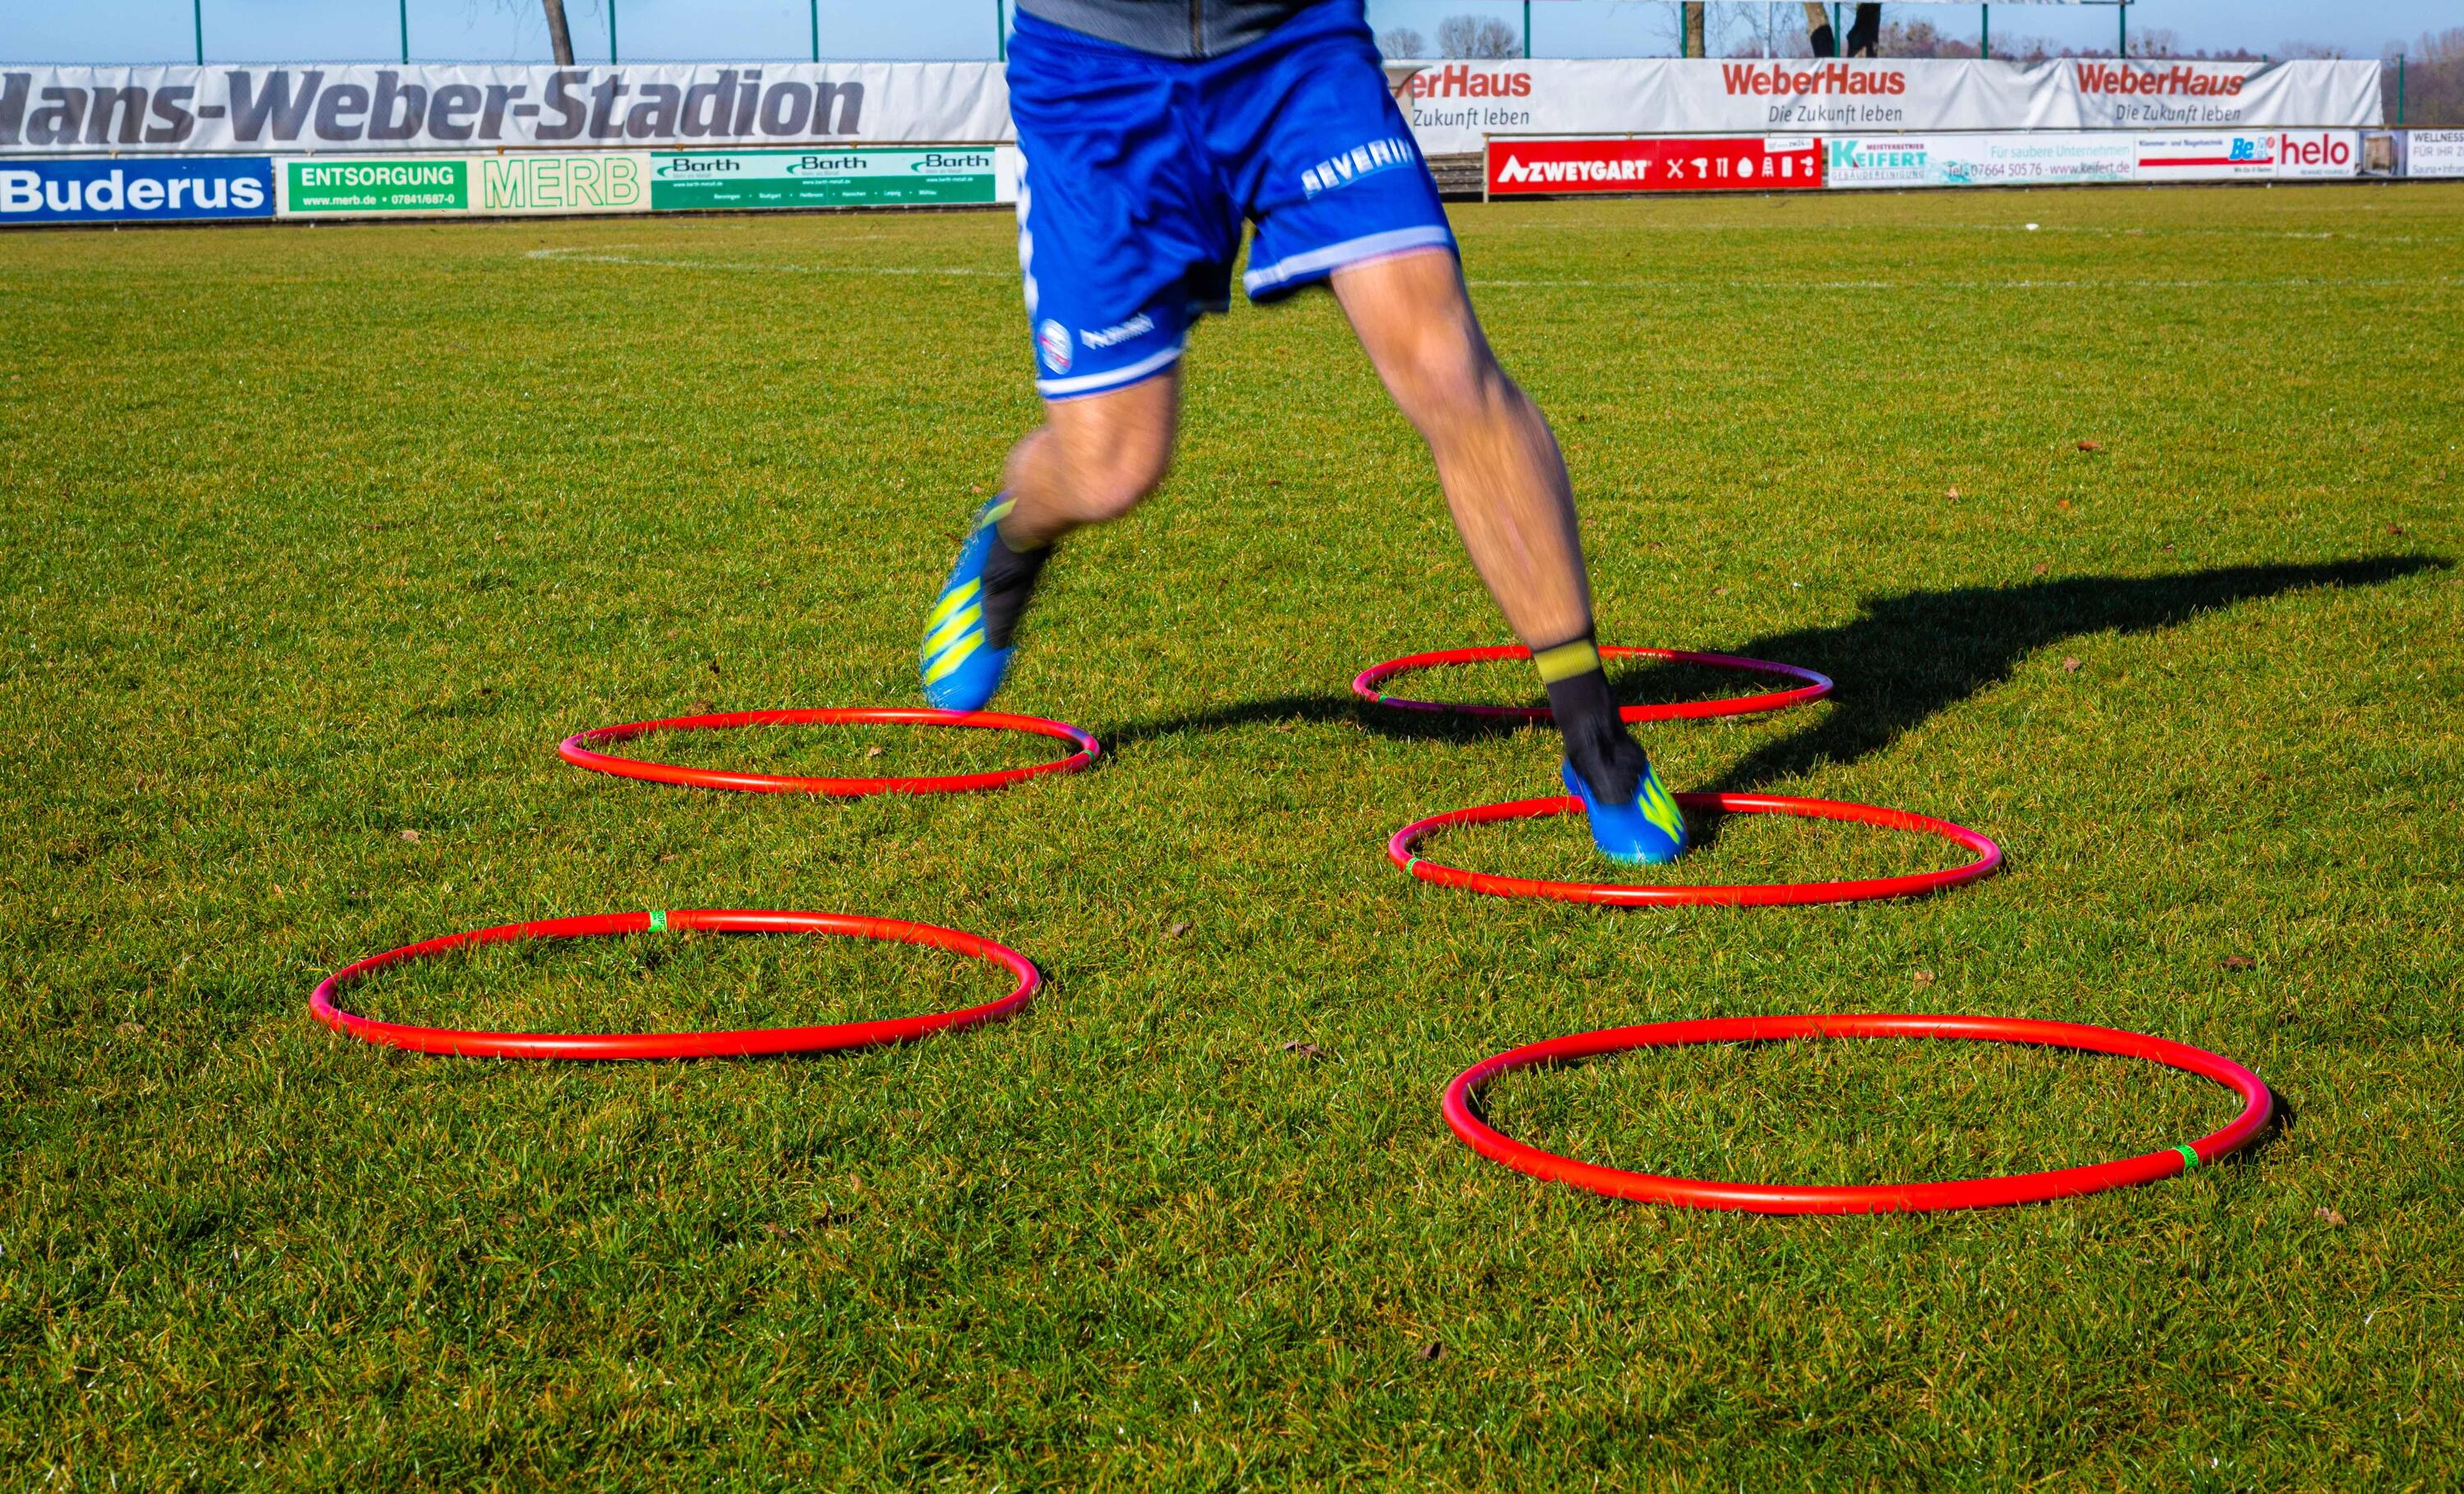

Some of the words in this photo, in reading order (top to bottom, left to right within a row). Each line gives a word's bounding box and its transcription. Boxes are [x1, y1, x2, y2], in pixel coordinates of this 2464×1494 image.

[1722, 62, 1906, 95] WeberHaus
[2077, 63, 2246, 96] WeberHaus
[1414, 108, 1479, 130] Zukunft
[1484, 108, 1530, 126] leben
[1768, 105, 1792, 122] Die
[1797, 105, 1856, 125] Zukunft
[1861, 105, 1902, 122] leben
[2117, 104, 2139, 121] Die
[2143, 104, 2198, 124] Zukunft
[2201, 106, 2241, 121] leben
[1832, 140, 1927, 168] KEIFERT
[1991, 145, 2008, 159] Für
[2011, 145, 2053, 158] saubere
[2057, 143, 2130, 157] Unternehmen
[2281, 133, 2350, 165] helo
[673, 158, 740, 172] Barth
[802, 156, 867, 170] Barth
[926, 154, 990, 168] Barth
[1971, 163, 2005, 177] 07664
[2050, 162, 2131, 175] www.keifert.de
[301, 167, 454, 186] ENTSORGUNG
[484, 157, 641, 209] MERB
[0, 169, 264, 213] Buderus
[302, 195, 377, 205] www.merb.de
[391, 193, 455, 205] 07841/687-0
